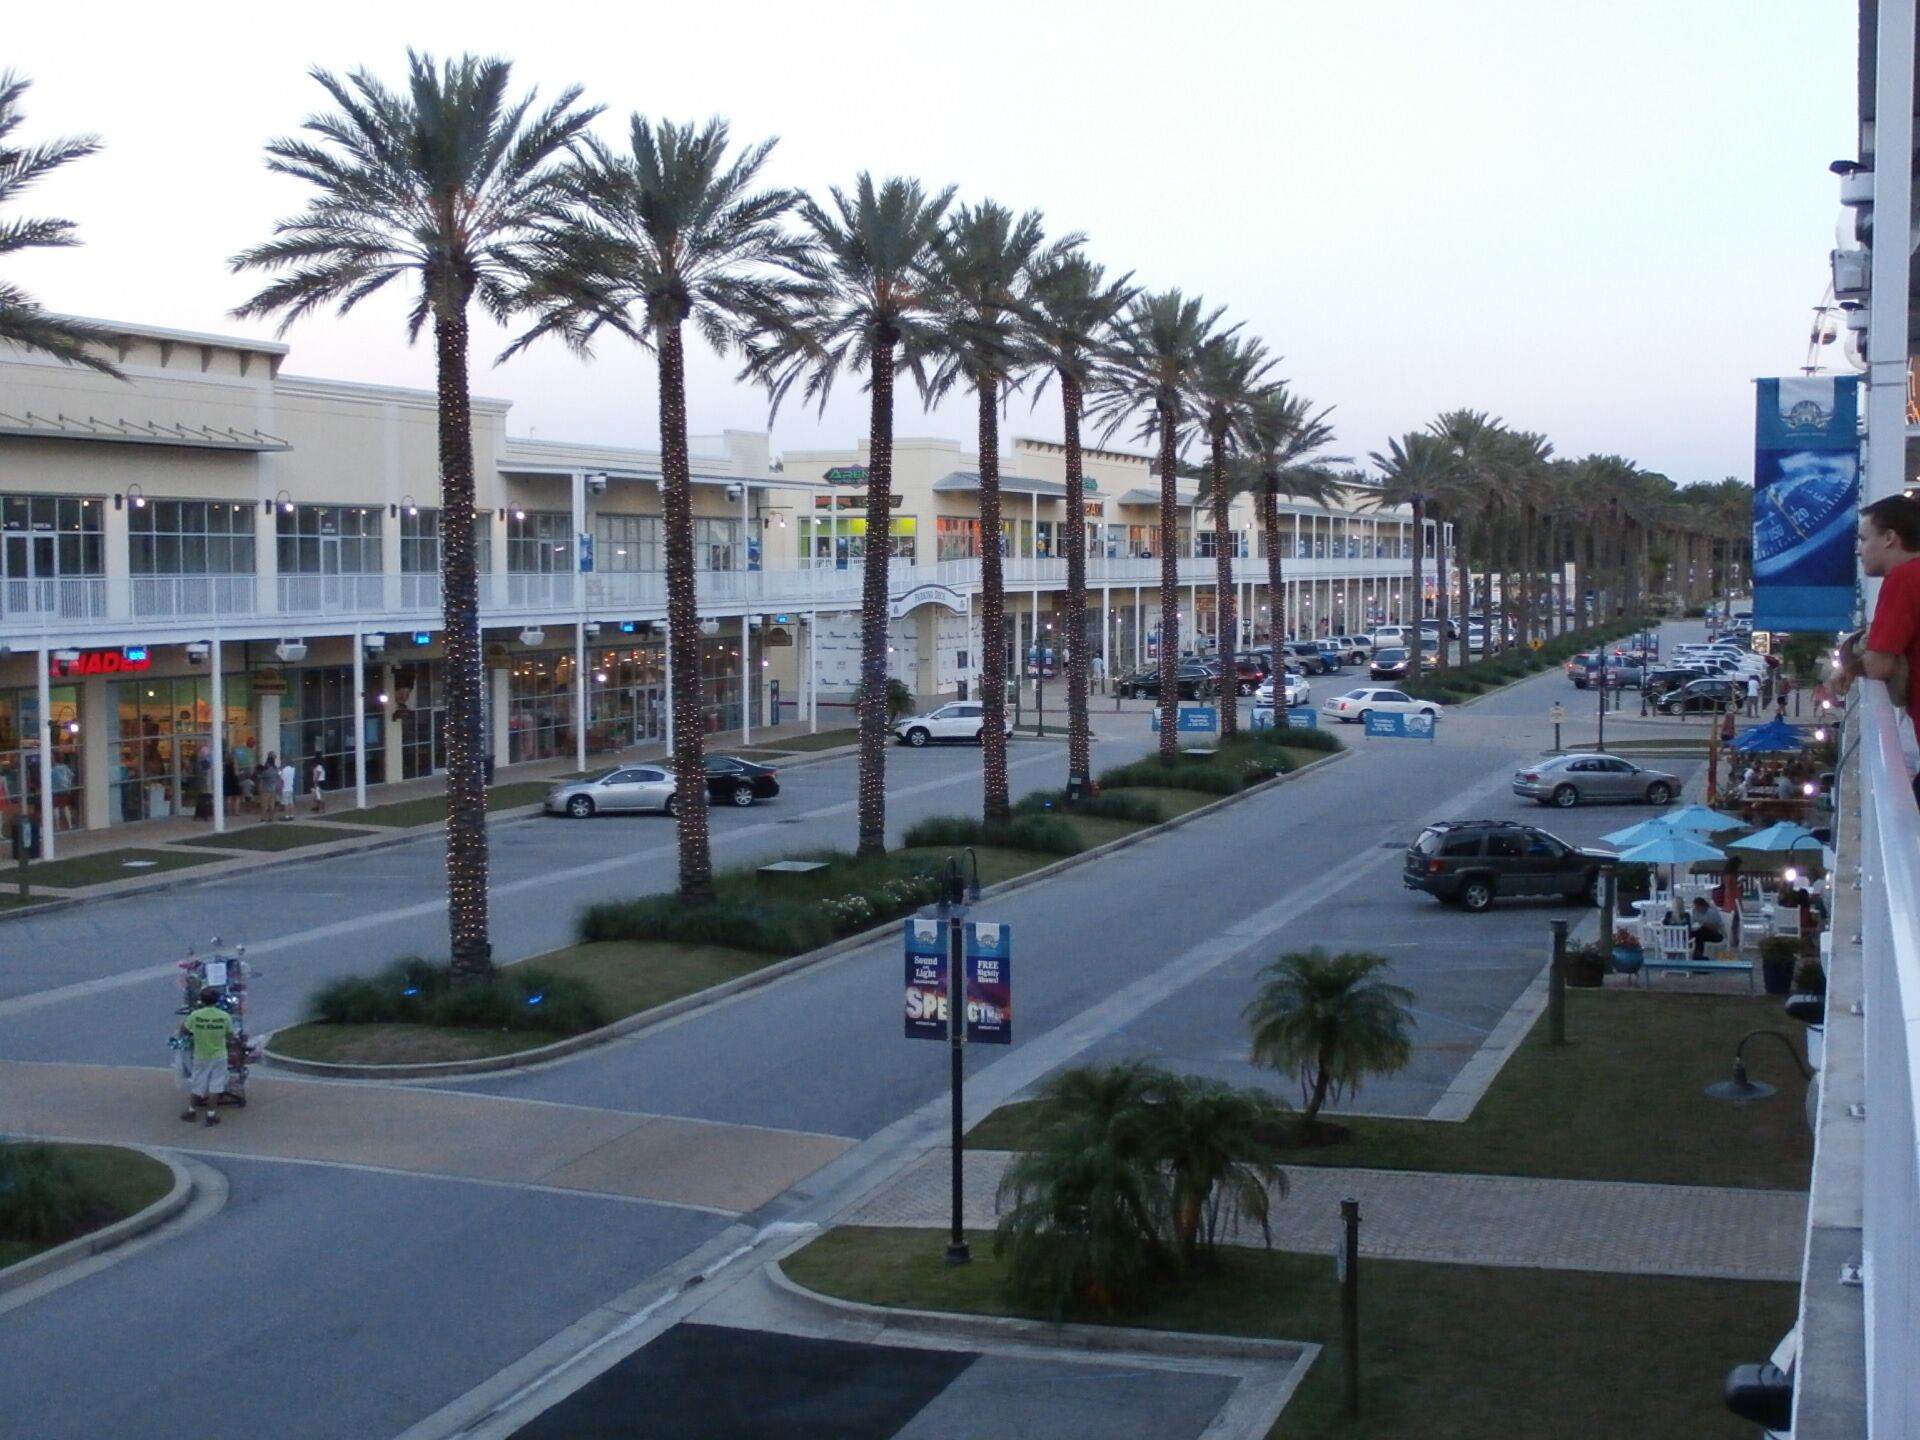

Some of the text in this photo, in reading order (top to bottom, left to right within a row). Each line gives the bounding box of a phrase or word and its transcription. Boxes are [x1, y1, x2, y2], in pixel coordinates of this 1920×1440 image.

[829, 470, 869, 479] AREN
[914, 956, 938, 965] Sound
[978, 960, 999, 969] FREE
[916, 969, 936, 979] Light
[977, 969, 999, 978] Nightly
[906, 987, 947, 1021] SPE
